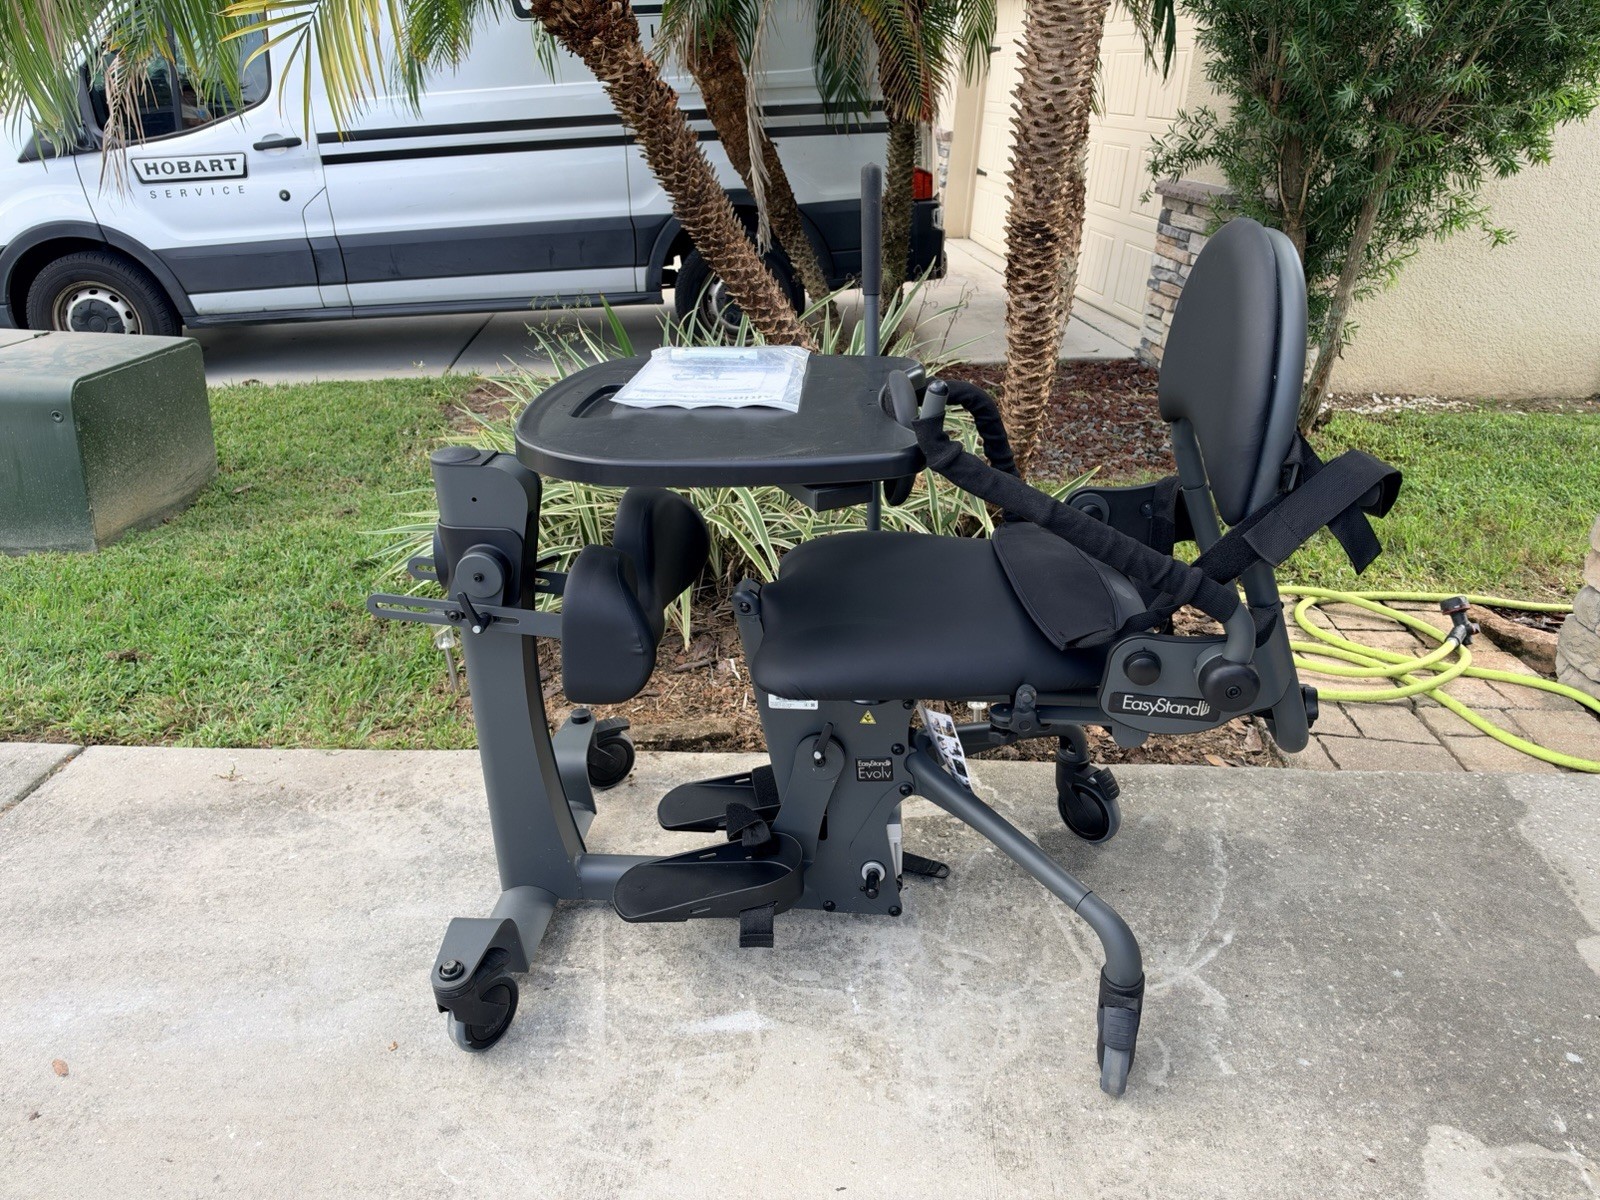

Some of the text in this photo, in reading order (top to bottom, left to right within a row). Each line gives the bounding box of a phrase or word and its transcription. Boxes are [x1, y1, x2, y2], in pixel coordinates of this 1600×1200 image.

[144, 158, 236, 175] HOBART
[149, 185, 245, 199] SERVICE
[1122, 694, 1202, 716] EasyStand
[858, 766, 891, 779] Evolv
